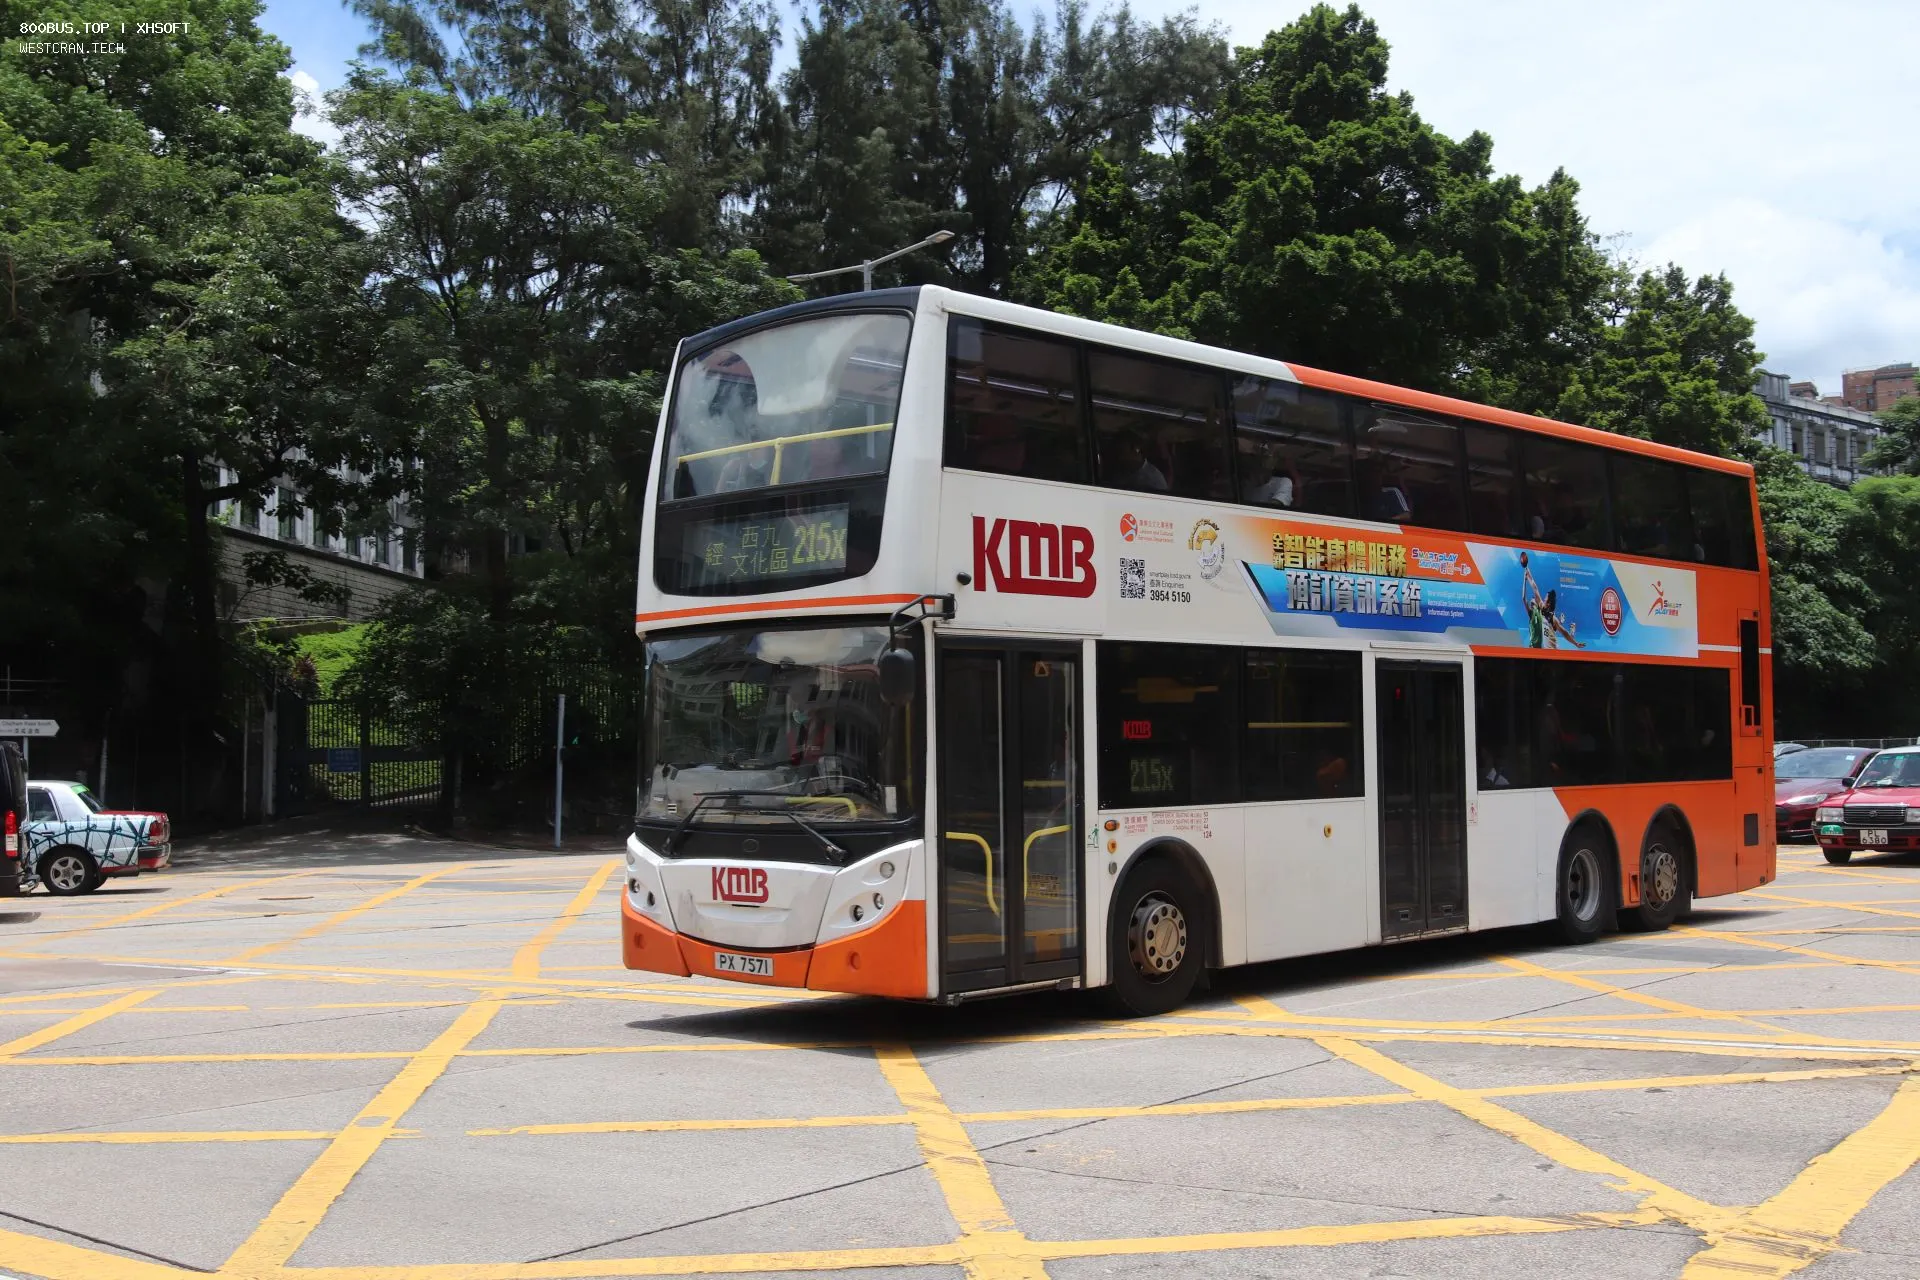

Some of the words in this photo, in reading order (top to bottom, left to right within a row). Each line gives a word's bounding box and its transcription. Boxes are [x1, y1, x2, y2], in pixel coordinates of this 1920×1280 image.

[741, 525, 780, 549] 西九
[705, 542, 726, 566] 經
[730, 547, 789, 577] 文化區
[973, 515, 1097, 598] KMB
[1284, 534, 1407, 577] 智能康體服務
[1150, 589, 1170, 602] 3954
[1171, 590, 1191, 603] 5150
[1286, 570, 1422, 618] 預訂資訊系統
[711, 866, 769, 903] KMB
[719, 954, 735, 970] PX
[740, 957, 769, 974] 7571
